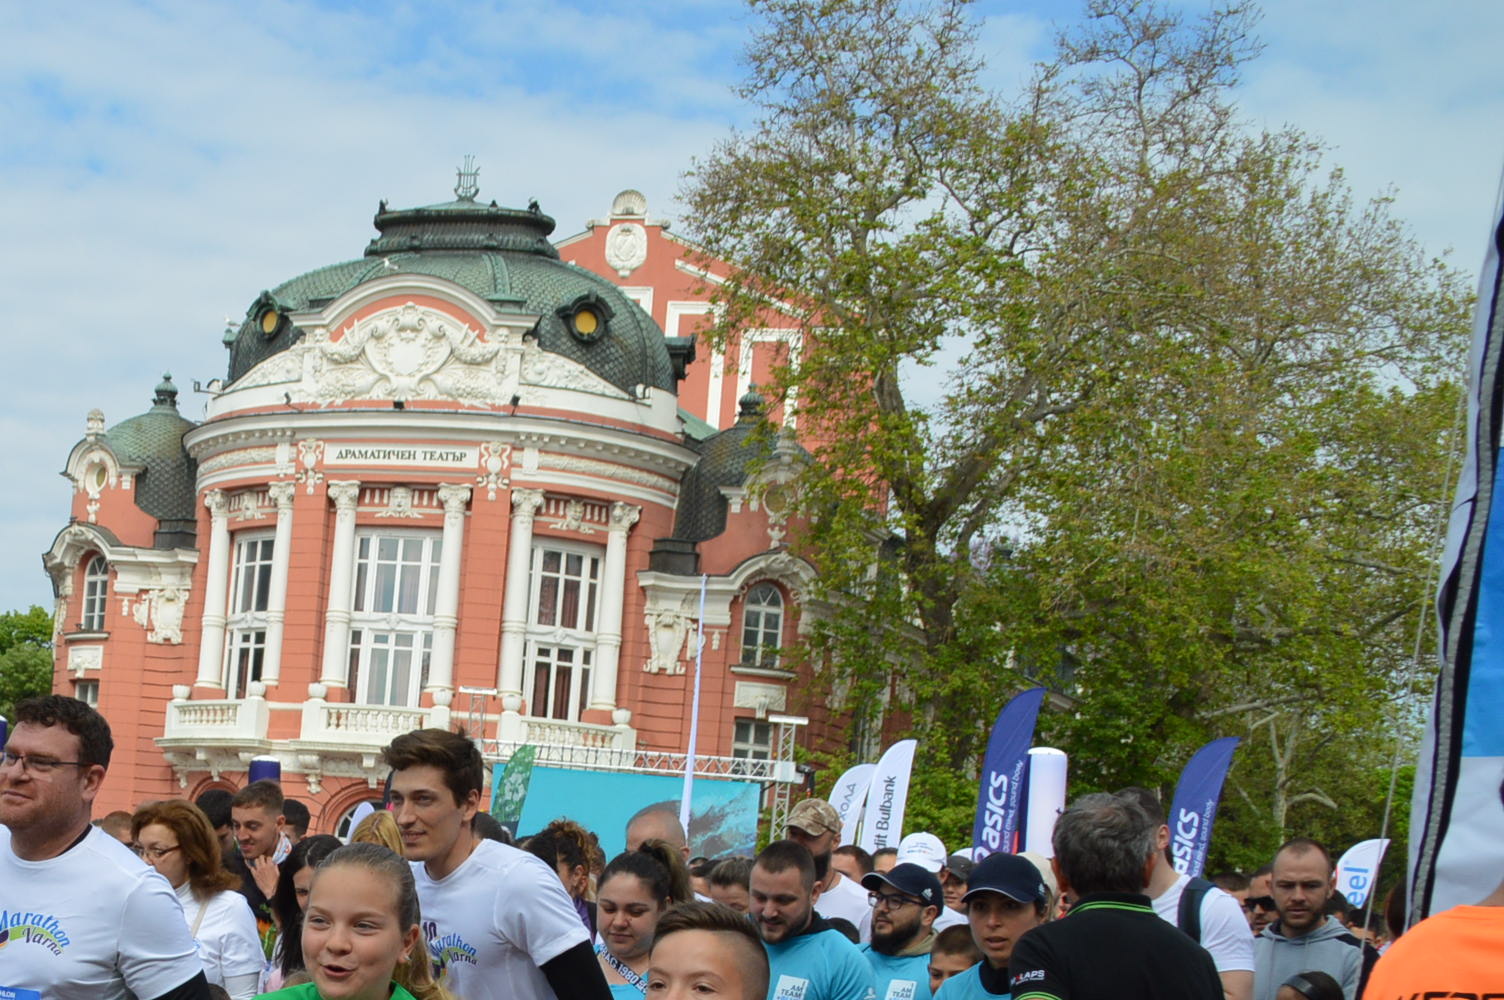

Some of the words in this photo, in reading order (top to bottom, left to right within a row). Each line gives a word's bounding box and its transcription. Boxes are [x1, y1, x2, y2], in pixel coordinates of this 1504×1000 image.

[335, 449, 417, 461] ДРАМАТИЧЕН
[421, 451, 467, 462] ТЕАТЪР
[876, 775, 897, 832] Bulbank
[981, 770, 1009, 851] asics
[21, 926, 63, 957] Varna
[616, 963, 640, 985] 1980
